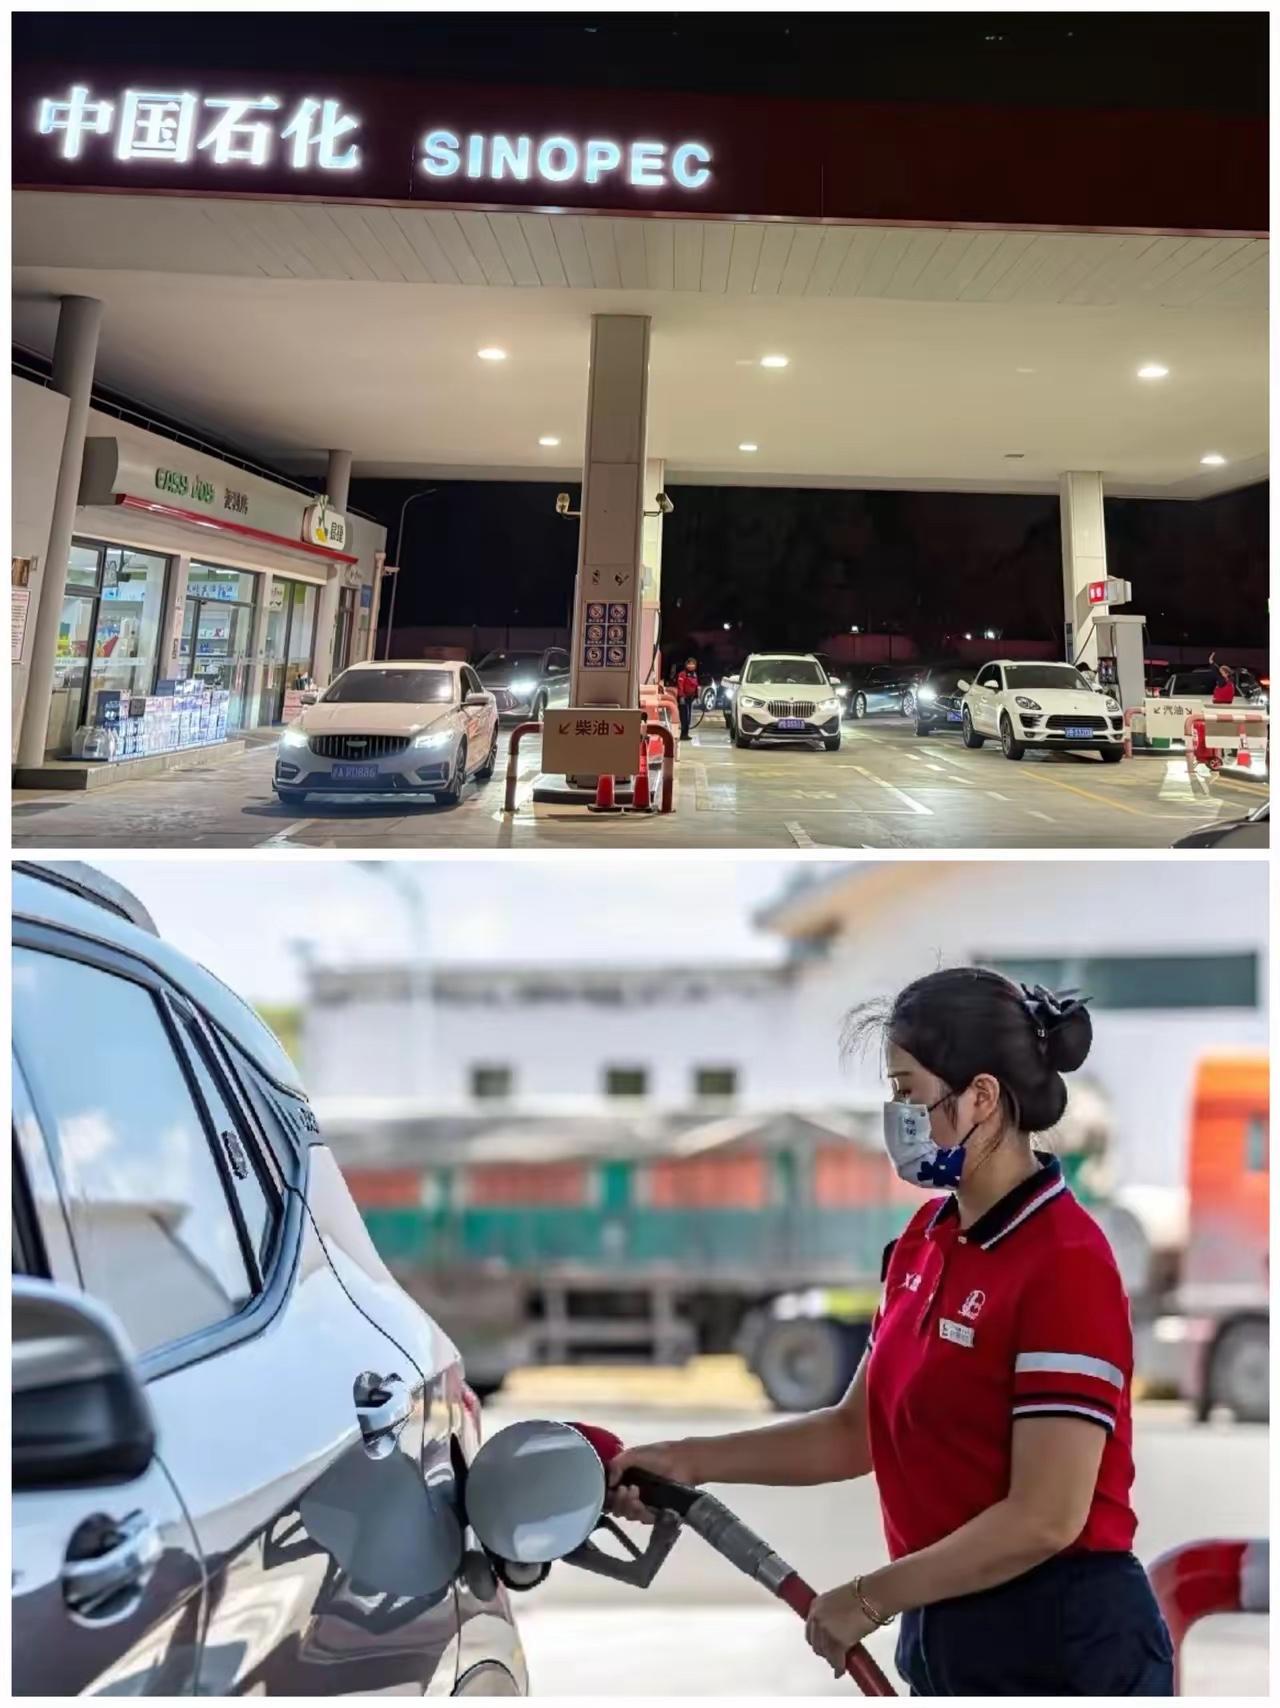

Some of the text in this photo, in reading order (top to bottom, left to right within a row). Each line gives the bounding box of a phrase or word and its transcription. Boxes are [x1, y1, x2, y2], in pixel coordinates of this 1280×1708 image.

[38, 86, 361, 171] 中国石化
[421, 130, 713, 190] SINOPEC
[575, 719, 610, 736] 柴油
[1163, 704, 1184, 716] 汽油
